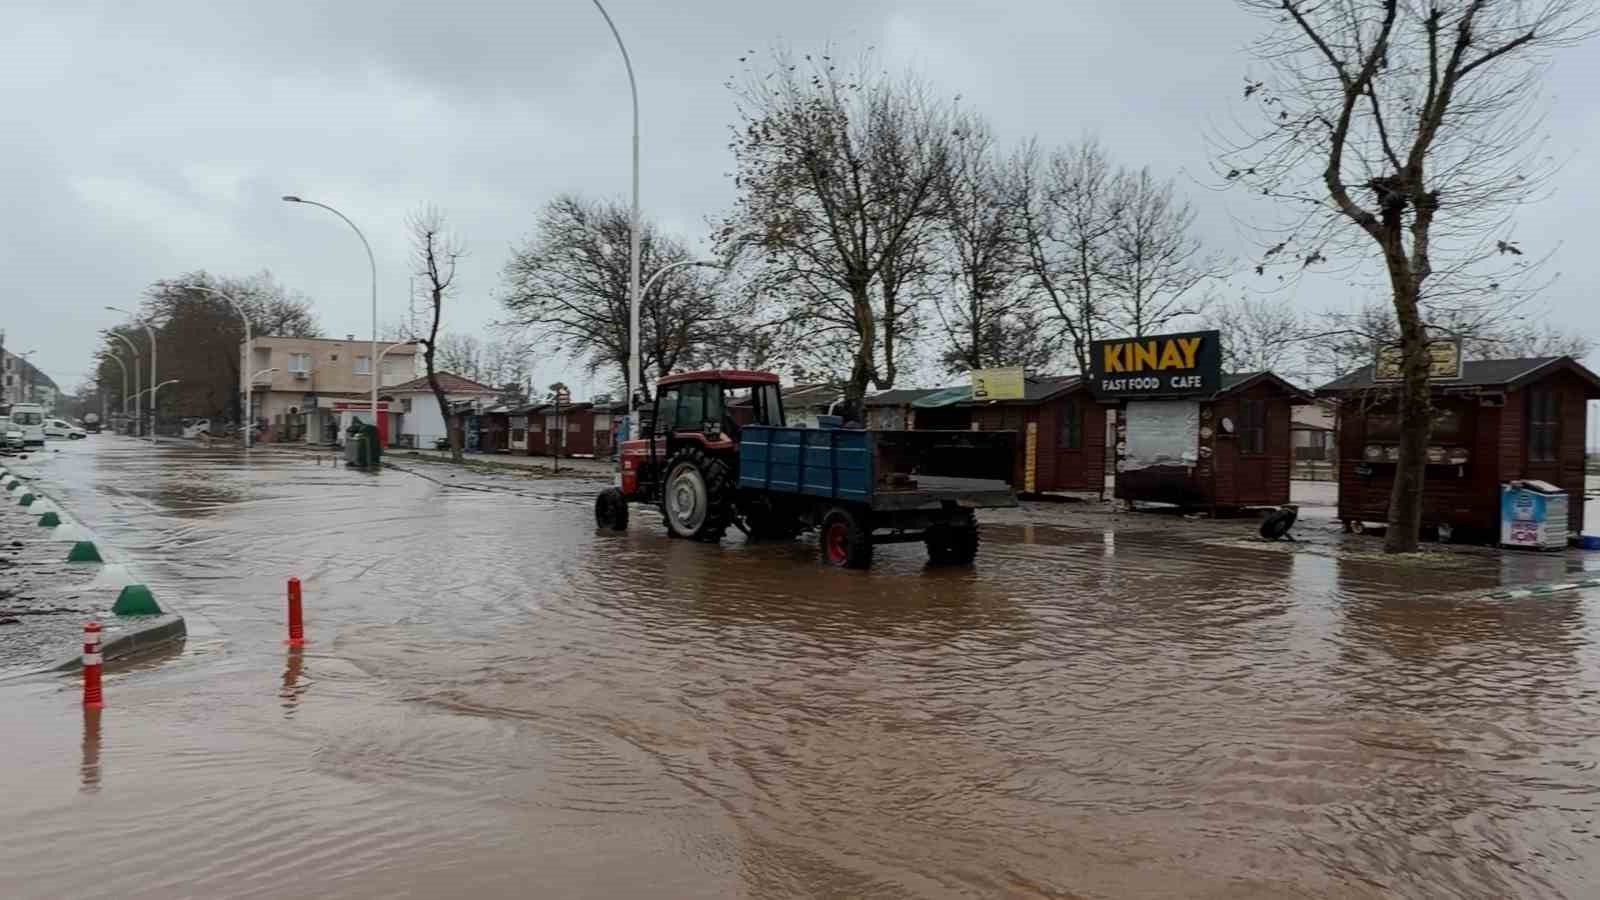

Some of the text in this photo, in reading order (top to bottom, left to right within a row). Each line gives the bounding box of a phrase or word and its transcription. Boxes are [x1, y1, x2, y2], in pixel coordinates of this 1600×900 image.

[1104, 336, 1201, 373] KINAY
[1102, 375, 1202, 391] FAST FOOD CAFE
